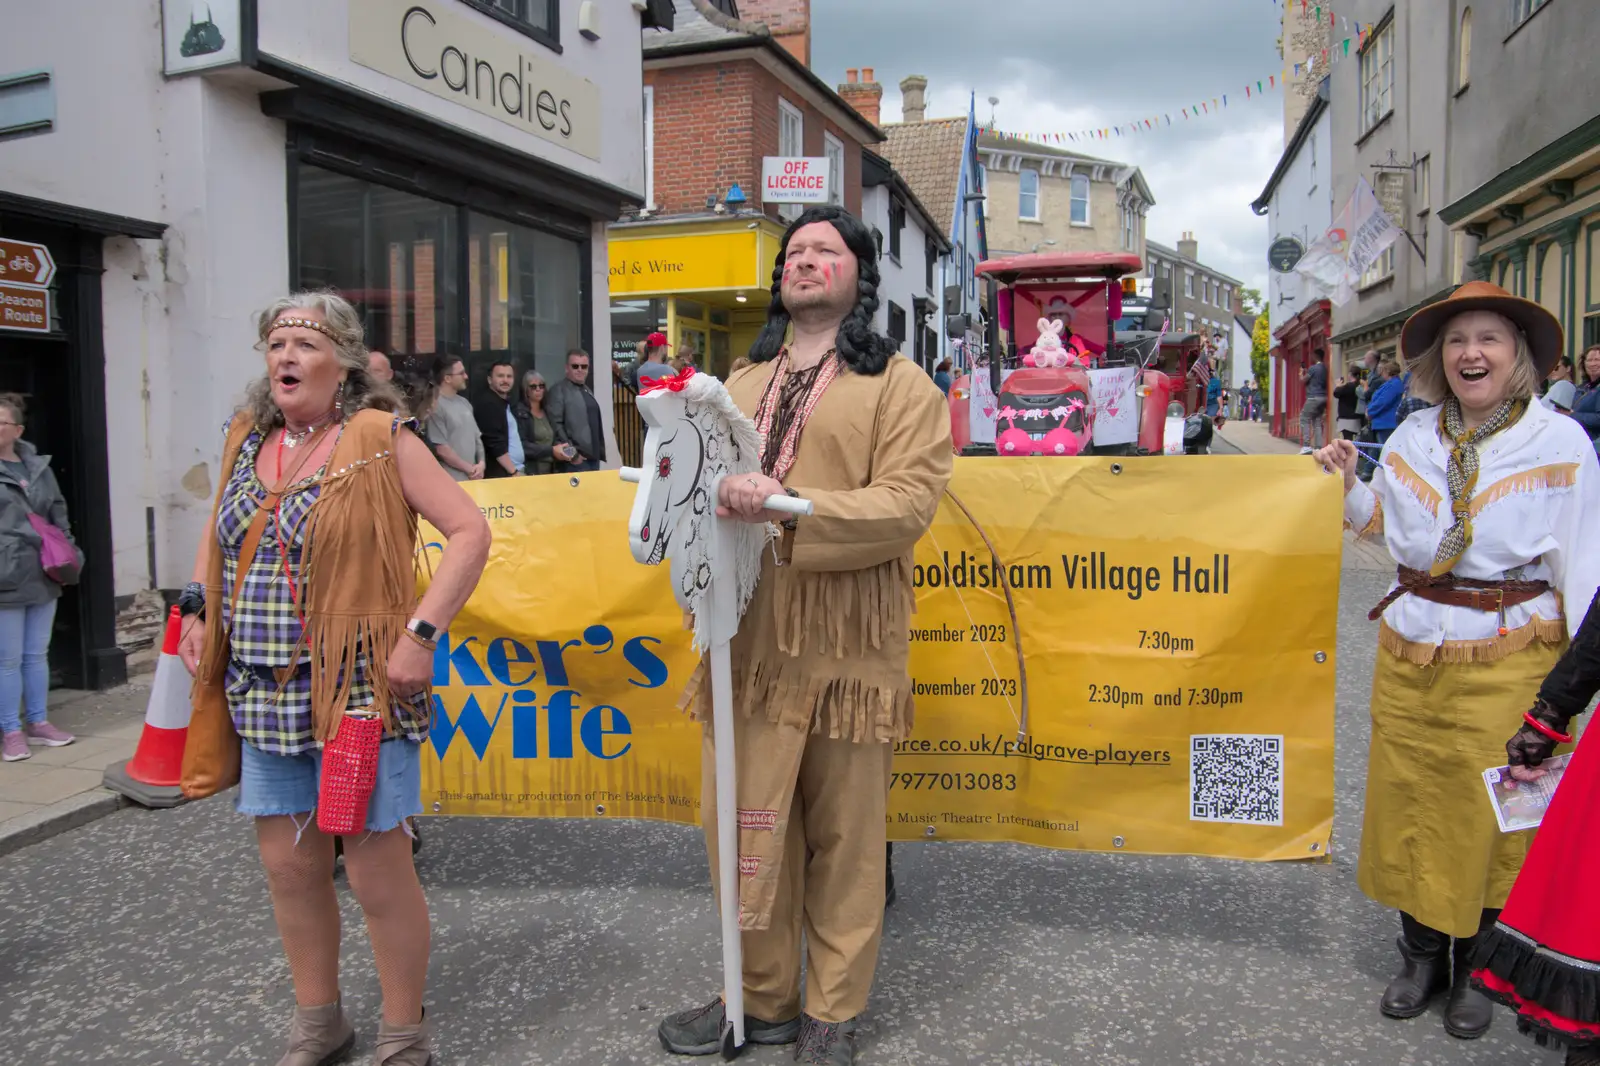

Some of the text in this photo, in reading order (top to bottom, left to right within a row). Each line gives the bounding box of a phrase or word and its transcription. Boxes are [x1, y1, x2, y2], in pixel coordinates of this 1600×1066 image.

[401, 6, 571, 138] Candies
[784, 161, 809, 175] OFF
[767, 175, 824, 189] LICENCE
[632, 261, 642, 275] &
[648, 260, 685, 273] Wine
[4, 307, 43, 323] Route
[1061, 552, 1161, 600] Village
[1173, 554, 1229, 594] Hall
[970, 624, 1006, 642] 2023
[1138, 630, 1194, 654] 7:30pm
[981, 678, 1017, 696] 2023
[1088, 684, 1243, 708] 2:30pm and 7:30pm
[429, 689, 632, 762] Wife
[437, 790, 462, 801] This
[466, 792, 513, 801] amateur
[517, 791, 581, 803] production
[584, 790, 597, 801] of
[599, 791, 621, 801] The
[625, 791, 665, 804] Baker's
[668, 796, 691, 808] Wife
[897, 812, 937, 824] Music
[941, 812, 992, 824] Theatre
[997, 812, 1079, 832] International
